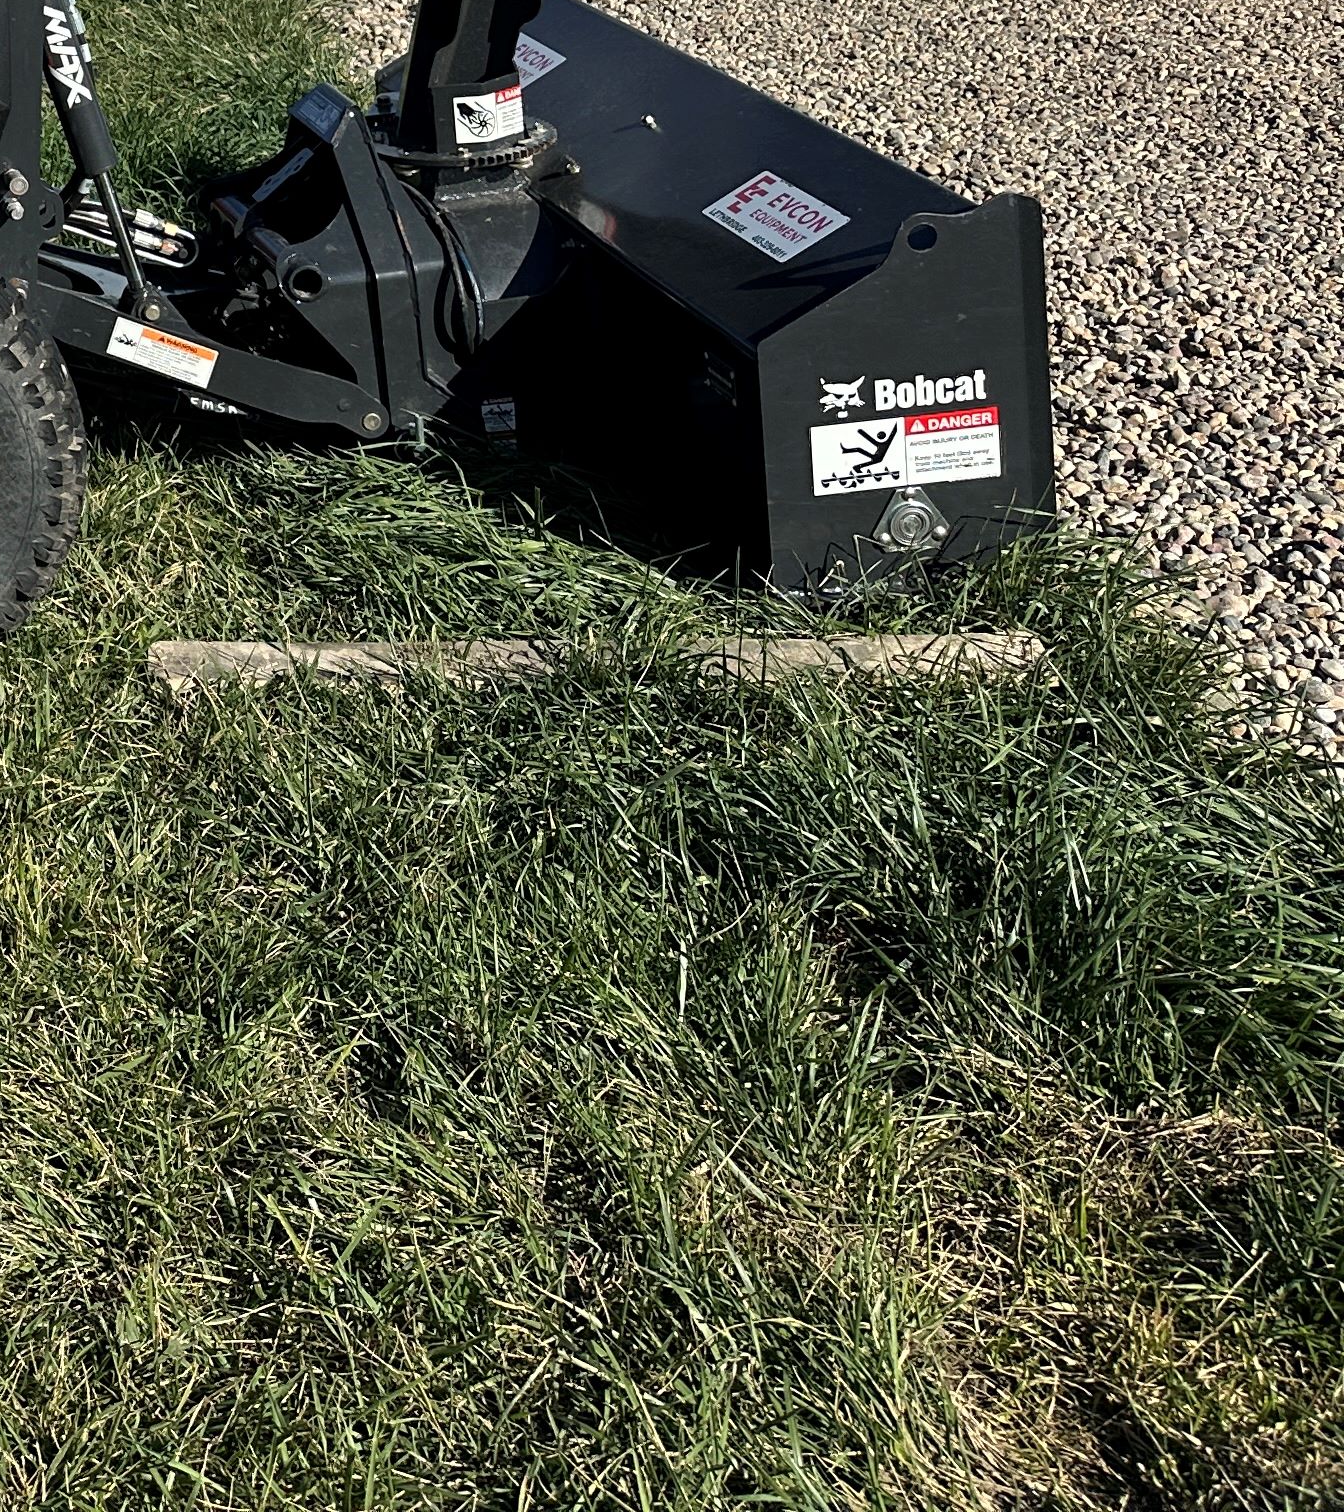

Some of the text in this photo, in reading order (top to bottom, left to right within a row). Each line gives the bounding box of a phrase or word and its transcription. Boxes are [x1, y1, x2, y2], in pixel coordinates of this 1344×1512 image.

[749, 208, 807, 244] EQUIPMENT
[767, 192, 833, 234] EVCON
[874, 368, 987, 412] Bobcat
[927, 412, 993, 431] DANGER
